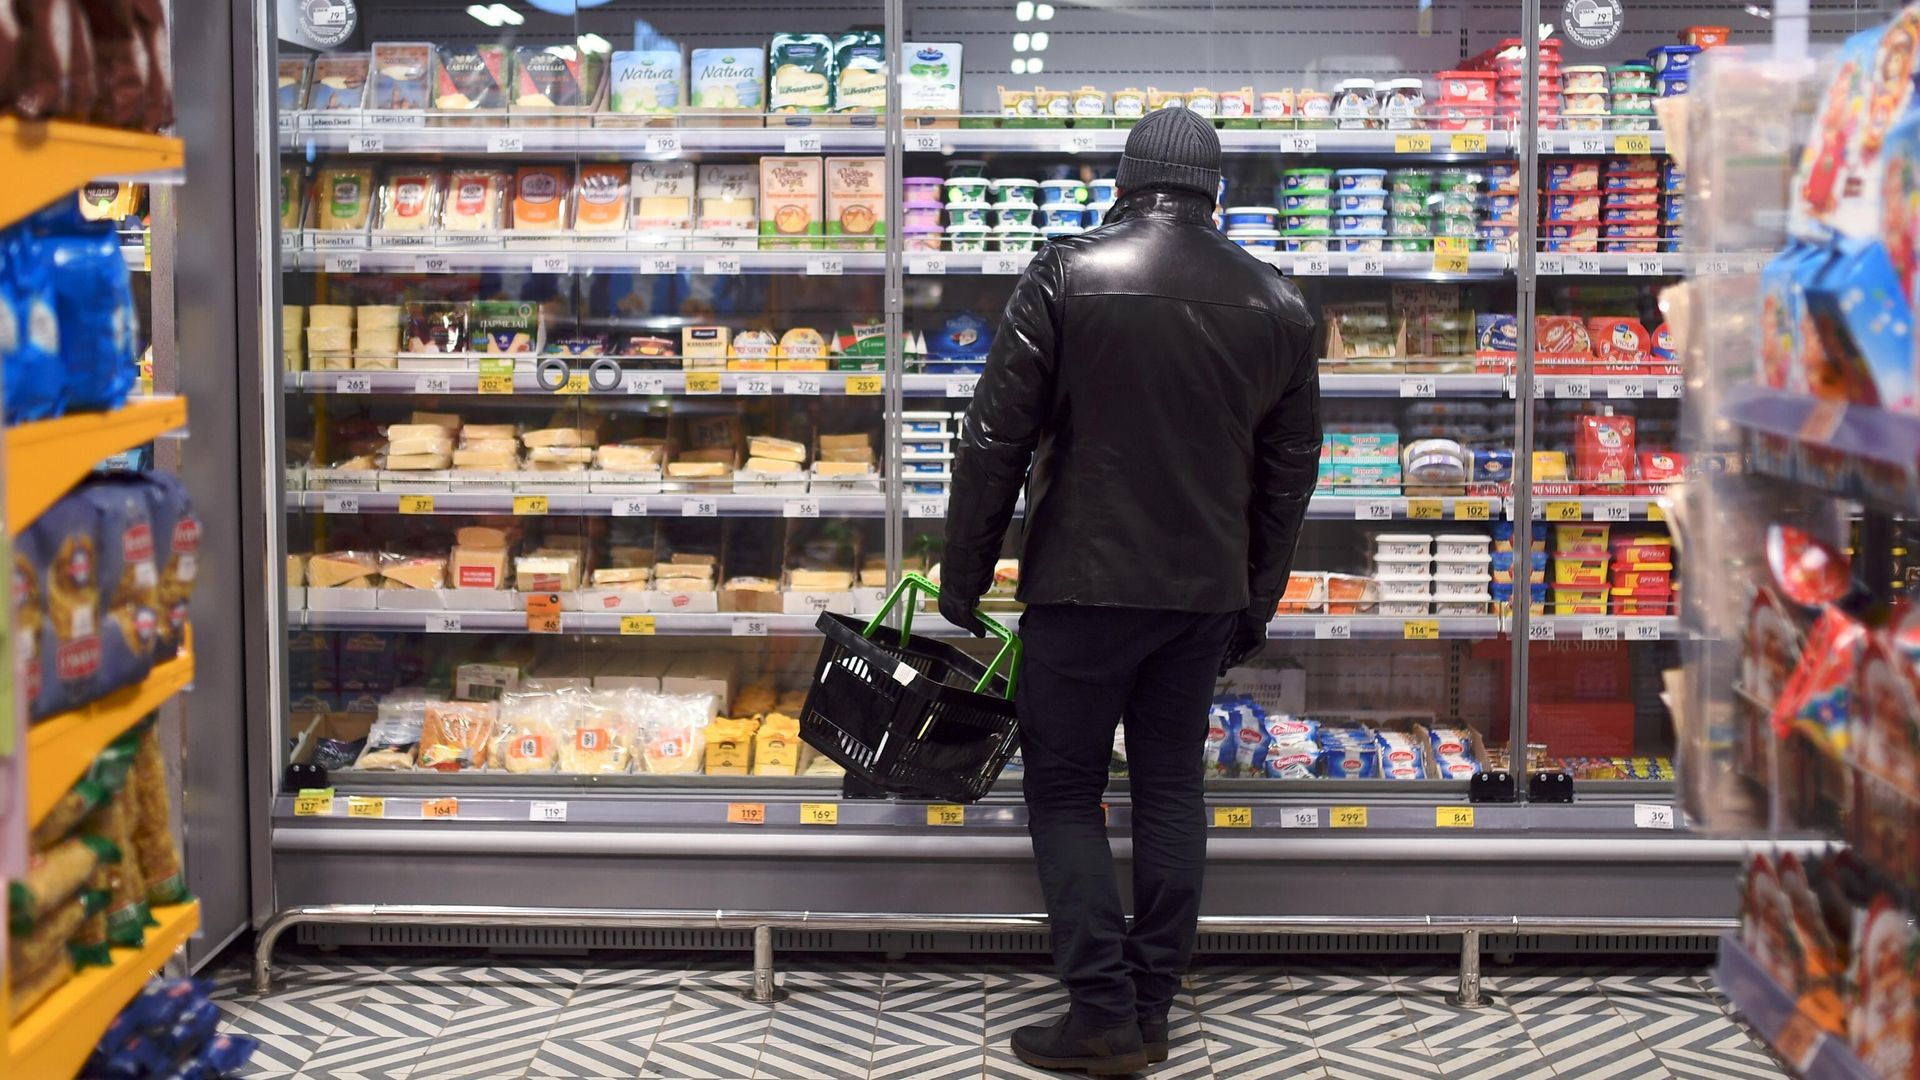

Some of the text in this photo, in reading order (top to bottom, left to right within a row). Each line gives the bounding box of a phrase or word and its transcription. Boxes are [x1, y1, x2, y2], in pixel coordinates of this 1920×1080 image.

[1565, 19, 1620, 46] МОЛОЧНОГО ЖИРА
[447, 63, 485, 71] CASTELLO
[620, 67, 673, 81] Natura
[700, 65, 754, 81] Natura
[361, 140, 377, 149] 149
[499, 140, 515, 148] 254
[657, 139, 674, 147] 190
[799, 140, 814, 148] 197
[917, 139, 933, 147] 102
[1294, 140, 1309, 148] 129
[1408, 140, 1424, 149] 179
[1463, 140, 1479, 149] 179
[1582, 141, 1598, 149] 157
[1627, 141, 1643, 149] 106
[88, 188, 115, 196] ЧЕДДЕР
[337, 260, 352, 268] 109
[426, 260, 442, 268] 109
[544, 260, 560, 268] 109
[655, 261, 671, 269] 104
[718, 261, 733, 269] 104
[822, 261, 836, 270] 124
[928, 261, 939, 269] 90
[999, 261, 1010, 270] 95
[1311, 262, 1322, 270] 85
[1365, 262, 1376, 270] 85
[1450, 261, 1461, 269] 79
[1540, 261, 1554, 270] 215
[1579, 261, 1593, 270] 215
[1640, 263, 1655, 271] 130
[1707, 262, 1721, 270] 215
[1615, 338, 1635, 349] VIOLA
[346, 381, 364, 389] 265
[427, 380, 442, 388] 254
[482, 380, 497, 388] 202
[634, 381, 648, 390] 167
[689, 383, 705, 391] 199
[748, 382, 764, 390] 272
[798, 382, 814, 390] 272
[857, 384, 874, 392] 259
[1417, 384, 1428, 393] 94
[1568, 385, 1582, 393] 102
[1625, 385, 1636, 393] 99
[341, 501, 352, 509] 69
[416, 501, 427, 509] 57
[530, 501, 541, 509] 47
[629, 503, 640, 512] 56
[699, 504, 710, 513] 58
[800, 504, 812, 513] 56
[920, 505, 937, 513] 163
[1370, 504, 1384, 512] 175
[1415, 507, 1427, 515] 59
[1467, 507, 1482, 515] 102
[1562, 507, 1574, 516] 69
[1608, 508, 1621, 516] 119
[1640, 551, 1665, 559] ДРУЖБА
[1640, 575, 1665, 584] ДРУЖБА
[445, 620, 455, 629] 34
[544, 620, 556, 629] 46
[629, 621, 641, 629] 46
[749, 623, 760, 631] 58
[1331, 627, 1342, 635] 60
[1411, 627, 1423, 635] 114
[1530, 628, 1547, 636] 205
[1594, 627, 1609, 635] 189
[1637, 627, 1652, 635] 187
[301, 803, 315, 811] 127
[434, 806, 450, 815] 164
[544, 809, 559, 817] 119
[742, 810, 756, 818] 119
[813, 811, 829, 819] 169
[940, 811, 956, 819] 139
[1652, 812, 1663, 821] 39
[1227, 814, 1244, 822] 134
[1295, 814, 1311, 823] 163
[1341, 814, 1358, 822] 299
[1455, 814, 1466, 822] 84
